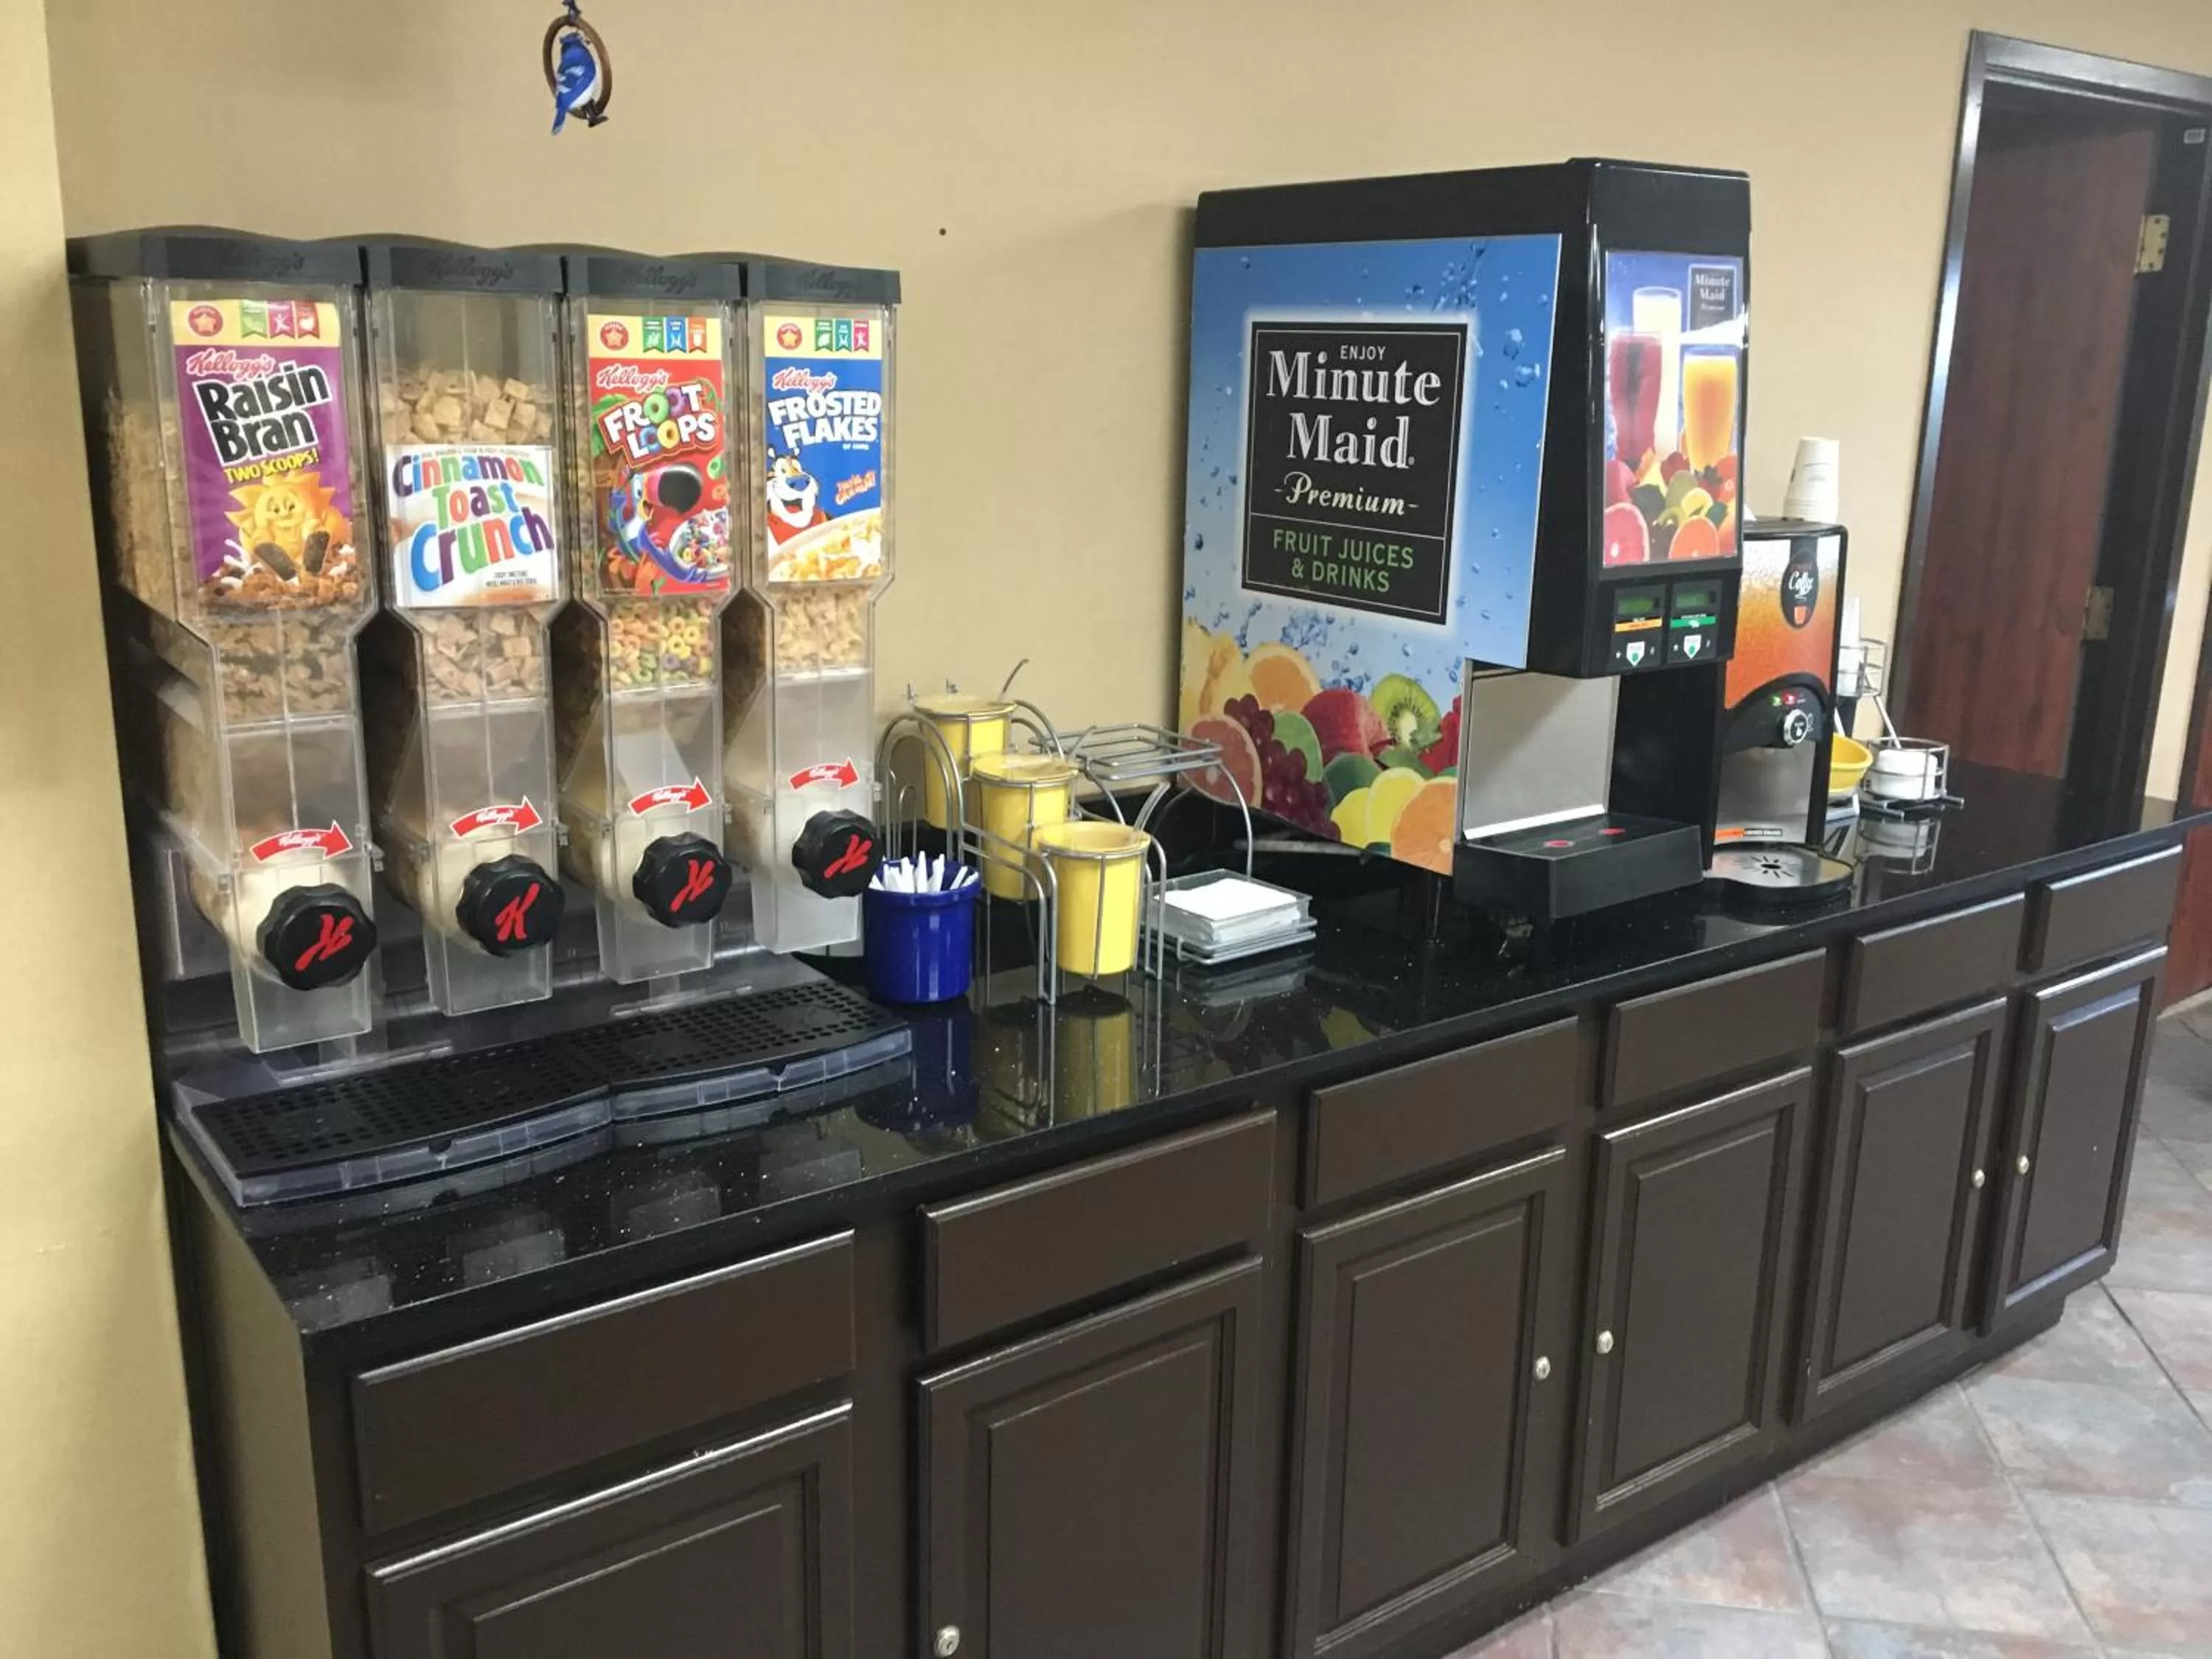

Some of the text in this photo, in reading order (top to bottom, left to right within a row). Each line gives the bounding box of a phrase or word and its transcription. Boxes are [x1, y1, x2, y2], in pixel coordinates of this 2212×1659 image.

[187, 348, 275, 380] Kellogg's
[1340, 344, 1385, 361] ENJOY
[195, 363, 331, 422] Raisin
[597, 364, 669, 392] Kellogg's
[773, 367, 837, 392] Kellogg's
[1266, 349, 1441, 406] Minute
[604, 383, 703, 442] FROOT
[768, 391, 882, 425] FROSTED
[210, 411, 317, 463] Bran
[627, 412, 715, 459] LOOPS
[782, 417, 878, 449] FLAKES
[1286, 412, 1411, 470] Maid
[224, 448, 319, 484] TWO SCOOPS!
[392, 454, 545, 497] Cinnamon
[432, 481, 520, 530] Toast
[411, 507, 555, 591] Crunch
[1273, 529, 1414, 569] FRUIT JUICES
[1291, 557, 1390, 592] & DRINKS
